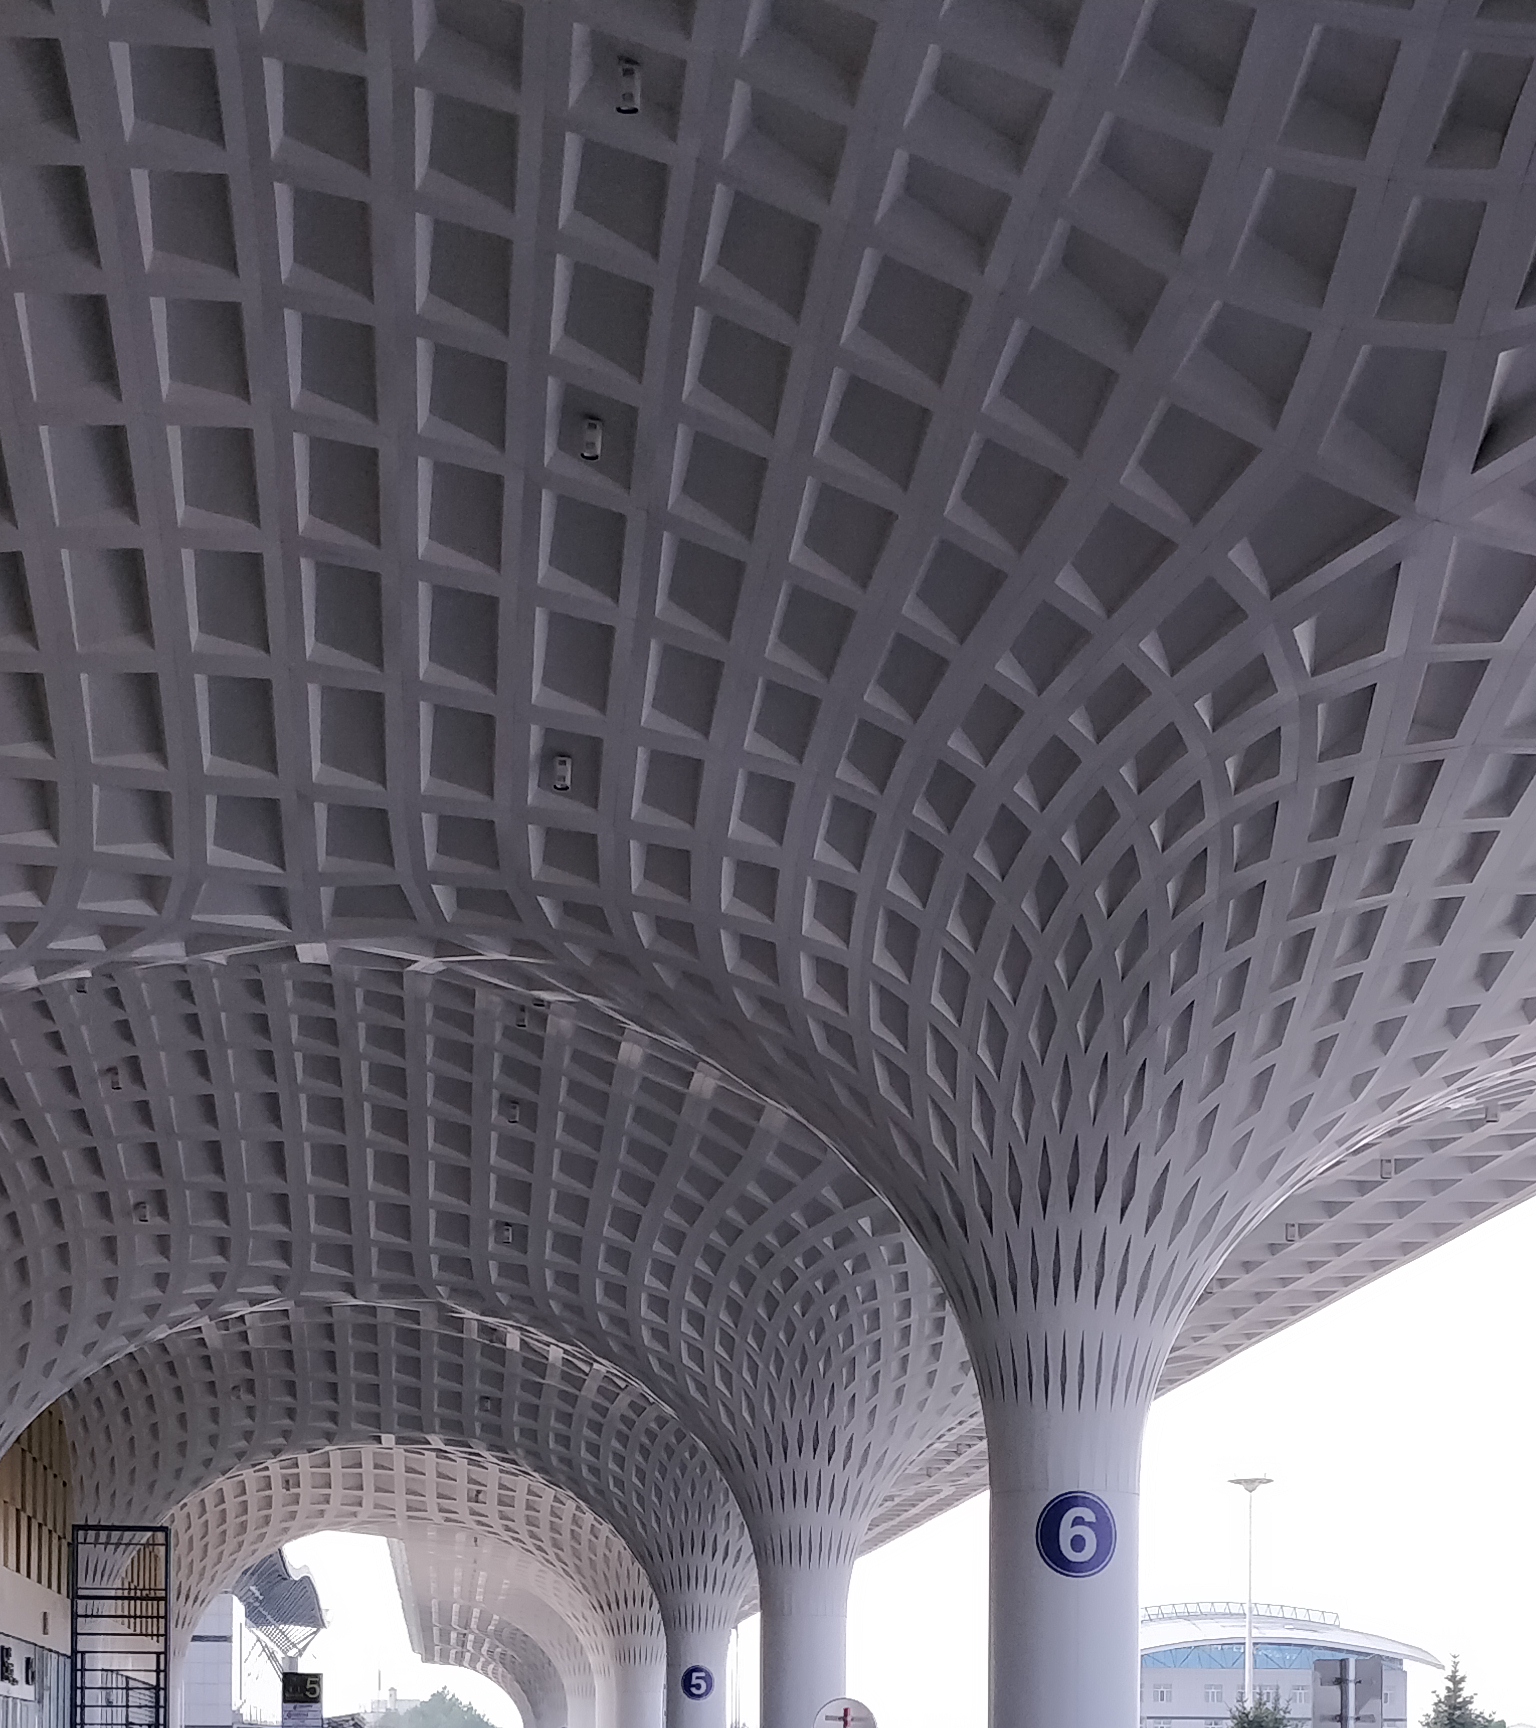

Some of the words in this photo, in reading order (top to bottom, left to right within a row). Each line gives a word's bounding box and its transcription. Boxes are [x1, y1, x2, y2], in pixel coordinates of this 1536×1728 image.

[1058, 1506, 1098, 1564] 6
[305, 1677, 320, 1698] 5
[689, 1671, 707, 1696] 5
